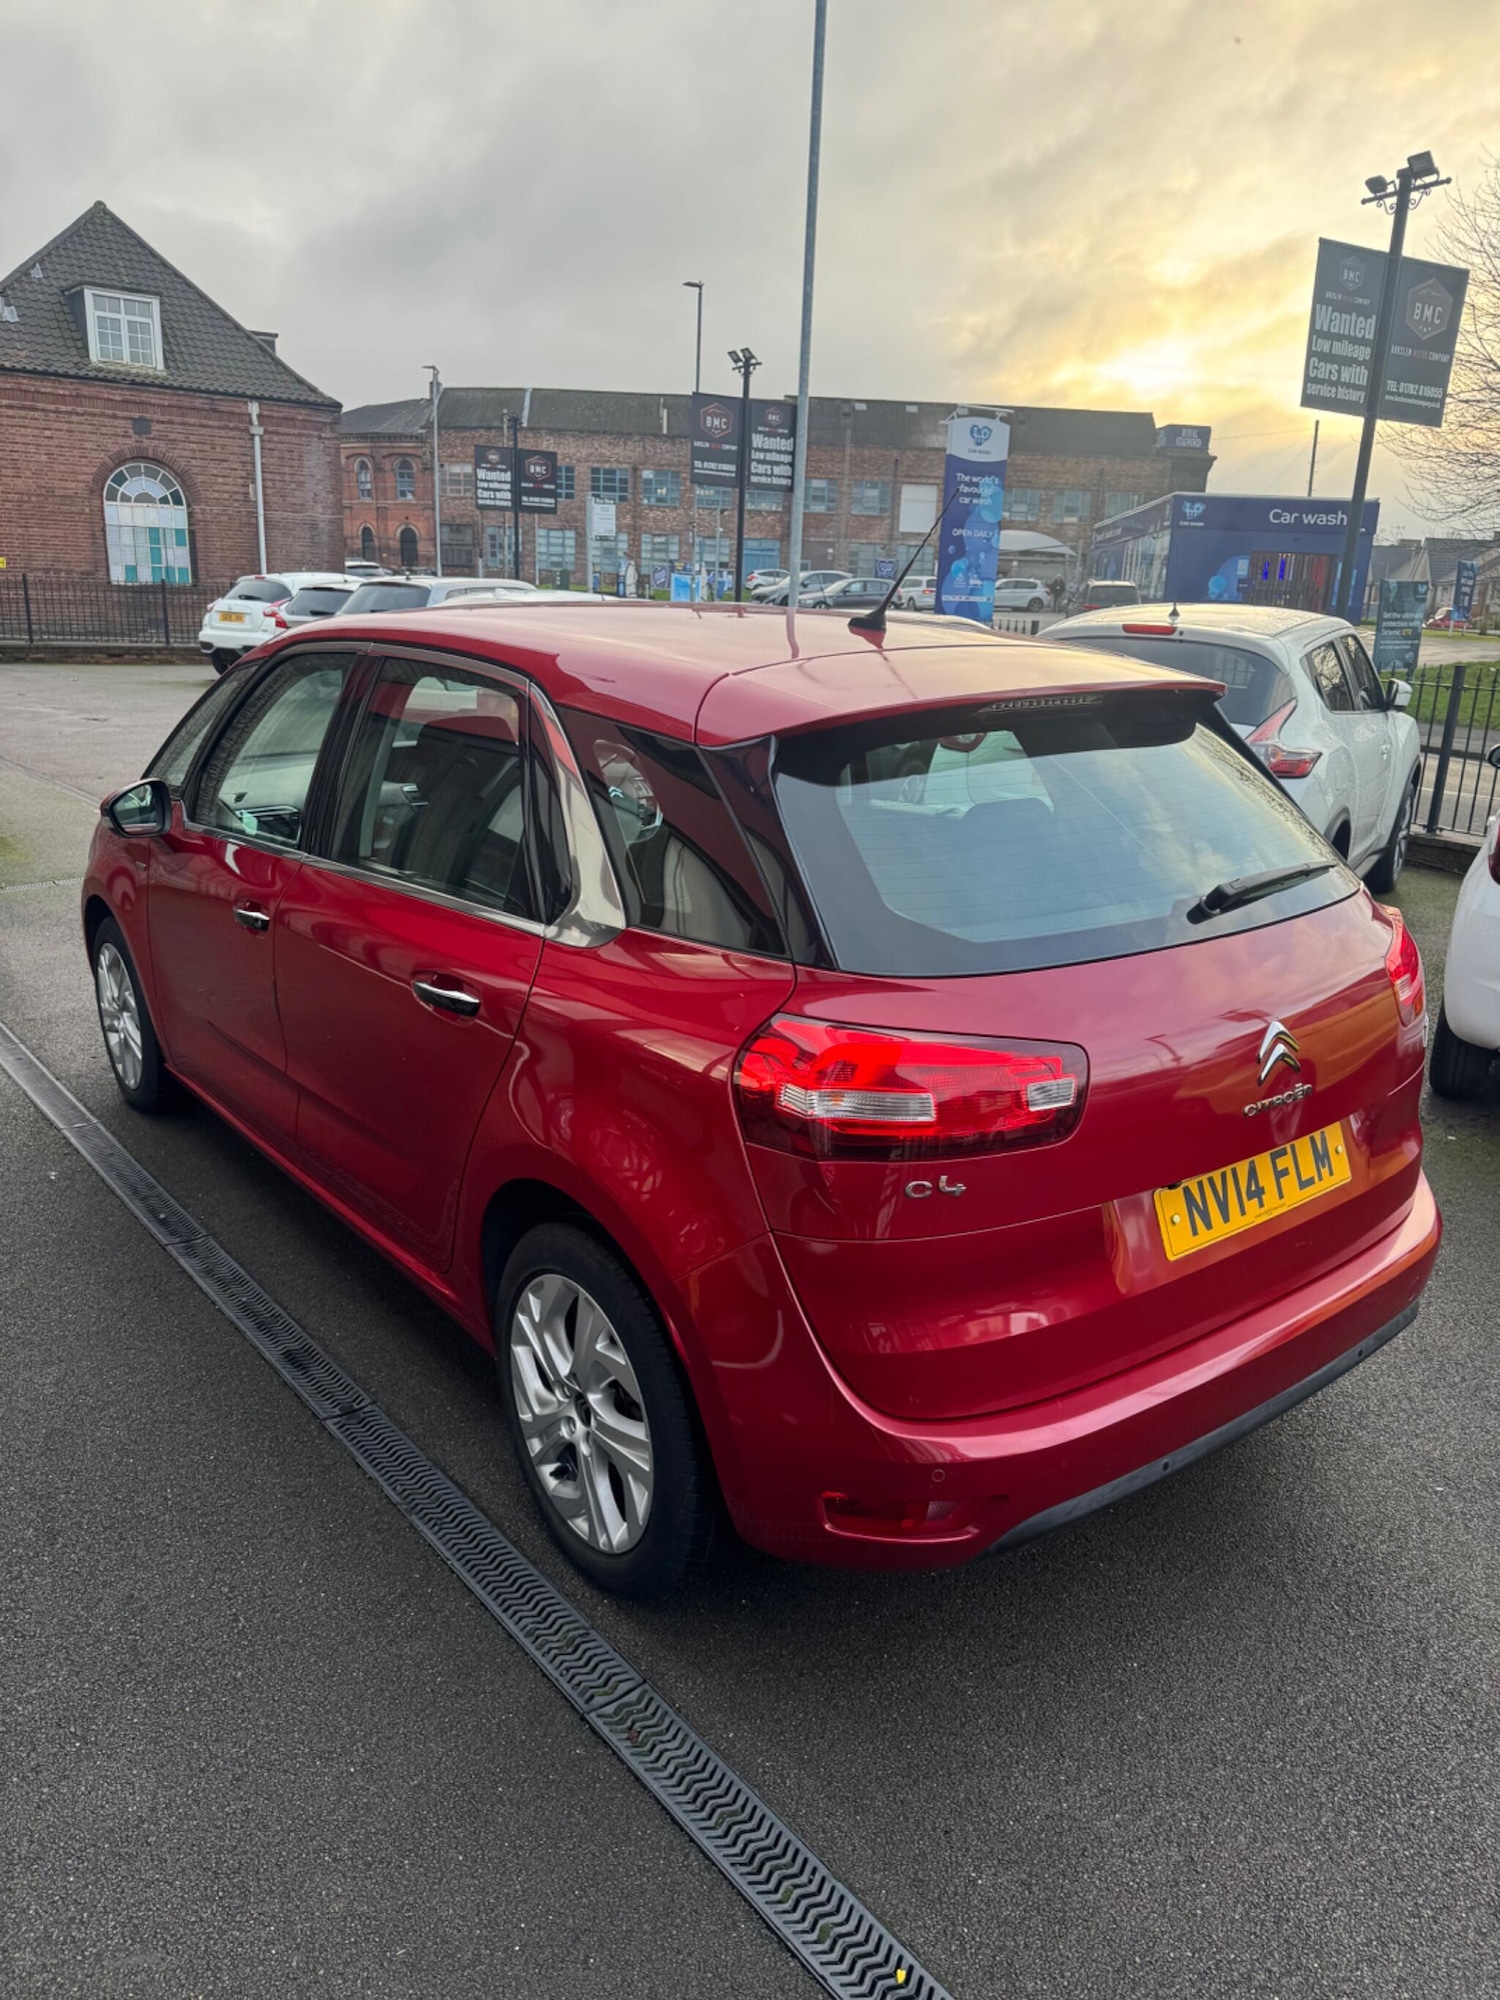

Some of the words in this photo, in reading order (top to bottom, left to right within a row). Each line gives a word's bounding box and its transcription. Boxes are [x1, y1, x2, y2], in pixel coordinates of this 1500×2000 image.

[1315, 303, 1377, 340] Wanted
[1413, 302, 1443, 325] BMC
[1312, 335, 1332, 352] Low
[1332, 340, 1371, 361] mileage
[1309, 357, 1338, 380] Cars
[1341, 363, 1368, 386] with
[1306, 382, 1337, 398] service
[1337, 386, 1366, 404] history
[706, 416, 727, 428] BMC
[752, 433, 794, 451] Wanted
[751, 450, 764, 460] Low
[765, 452, 792, 463] mileage
[477, 468, 511, 481] Wanted
[750, 462, 772, 474] Cars
[773, 464, 792, 476] with
[956, 472, 970, 483] The
[477, 489, 495, 498] Cars
[1269, 508, 1299, 524] Car
[1302, 510, 1348, 526] wash
[952, 528, 972, 537] OPEN
[973, 529, 993, 538] DAILY
[905, 1175, 967, 1198] C4
[1183, 1159, 1265, 1237] NV14
[1270, 1130, 1334, 1200] FLM
